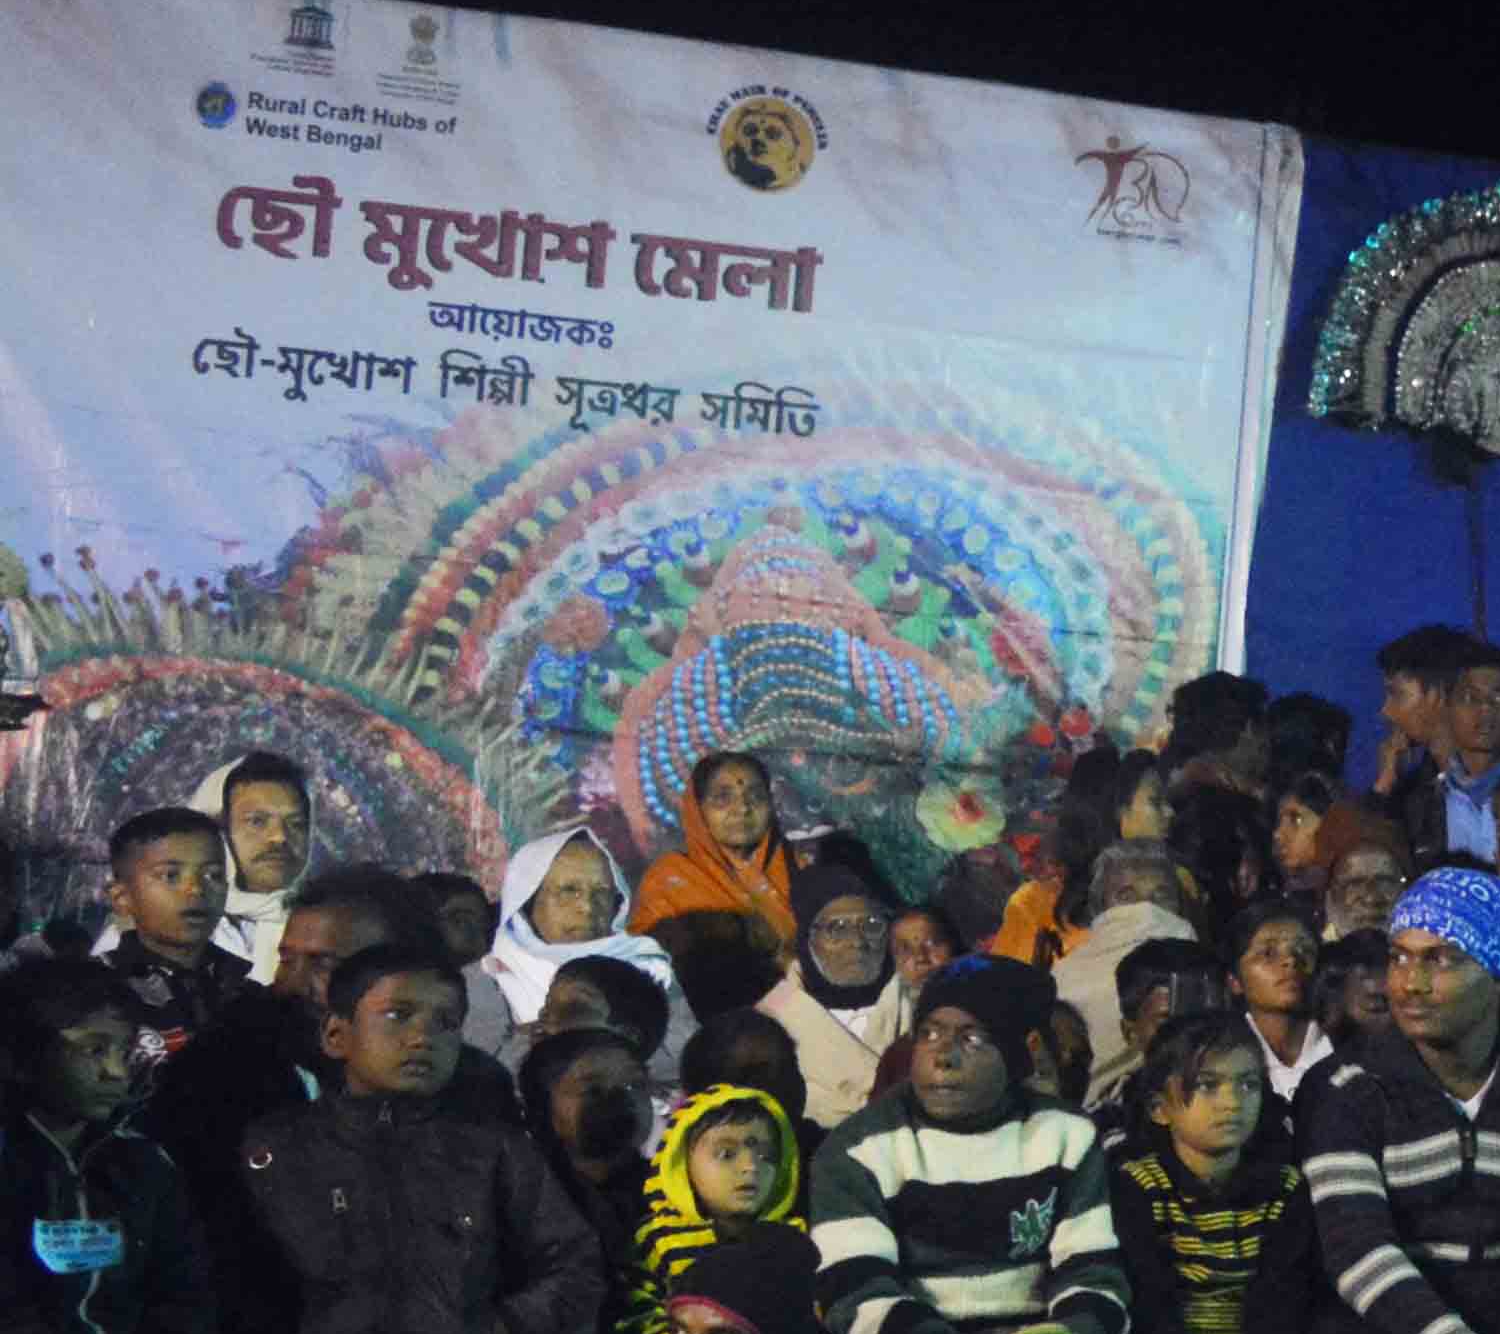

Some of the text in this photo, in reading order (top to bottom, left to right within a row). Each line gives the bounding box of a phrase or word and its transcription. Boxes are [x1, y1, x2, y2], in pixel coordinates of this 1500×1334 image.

[246, 117, 383, 153] West Bengal
[247, 92, 458, 135] Rural Craft Hubs of
[216, 175, 825, 314] ছৌ মুখোশ মেলা
[193, 327, 821, 438] ছৌ-মুখোশ শিল্পী সূত্রধর সমিতি
